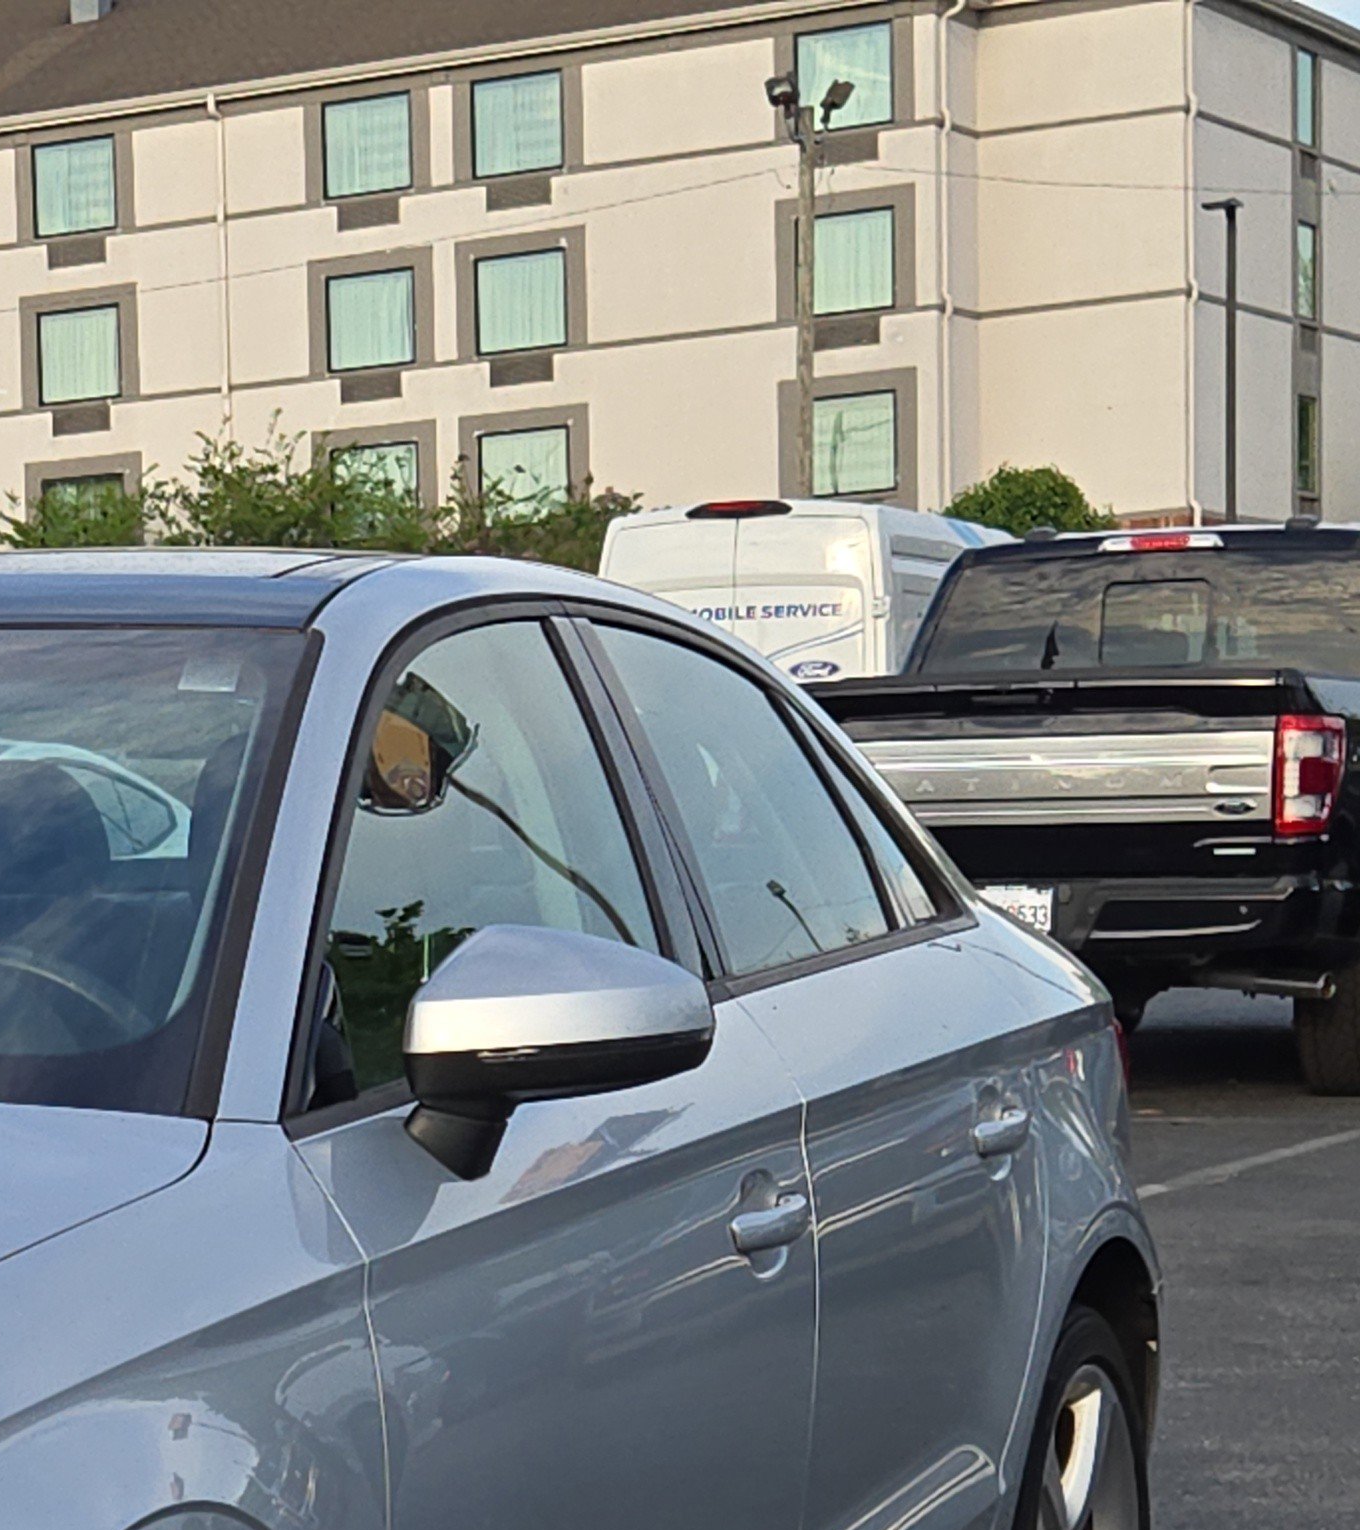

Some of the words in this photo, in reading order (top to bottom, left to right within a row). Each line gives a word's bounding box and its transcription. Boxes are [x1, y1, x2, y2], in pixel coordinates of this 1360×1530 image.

[692, 606, 756, 621] OBILE
[762, 603, 842, 618] SERVICE
[915, 772, 1183, 793] ATINUM
